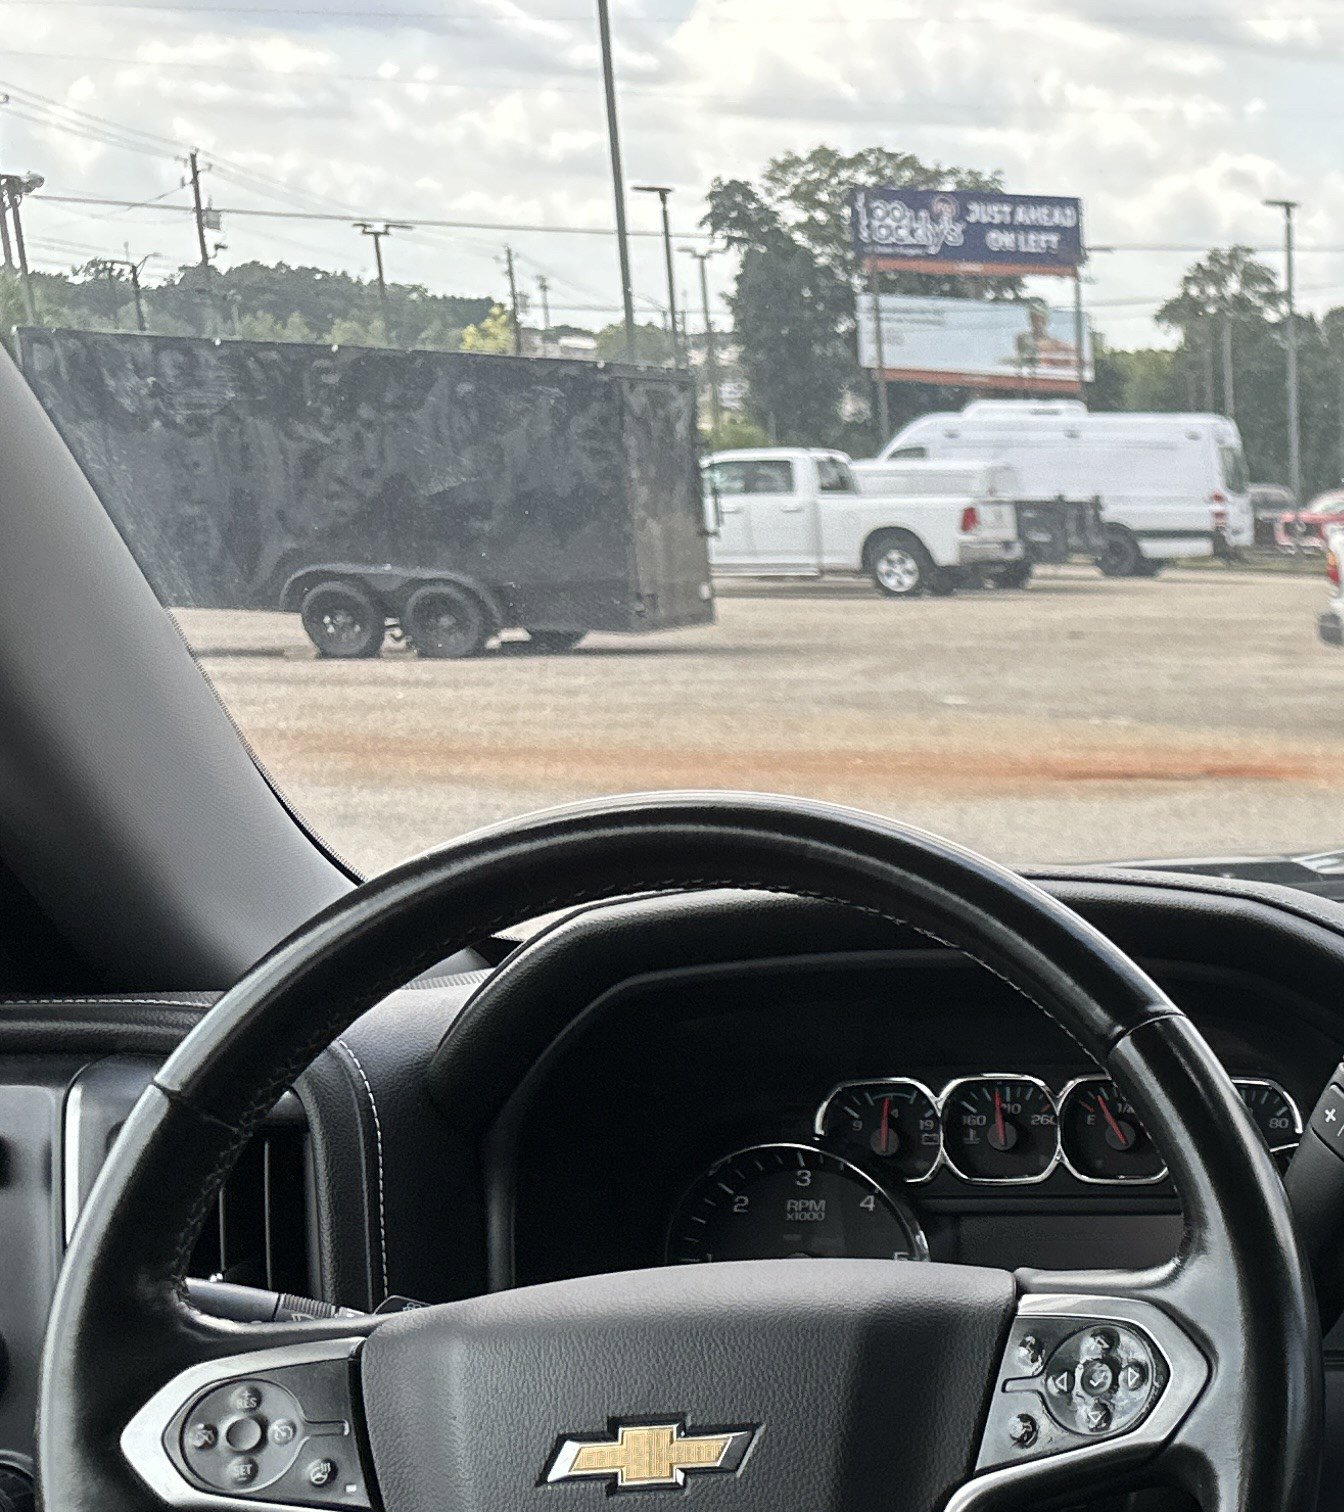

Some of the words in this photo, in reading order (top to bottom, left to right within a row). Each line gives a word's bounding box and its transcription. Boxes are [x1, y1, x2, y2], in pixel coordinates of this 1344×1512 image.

[1269, 1118, 1289, 1129] 80
[796, 1170, 812, 1186] 3
[733, 1196, 749, 1213] 2
[786, 1200, 826, 1212] RPM
[860, 1195, 875, 1211] 4
